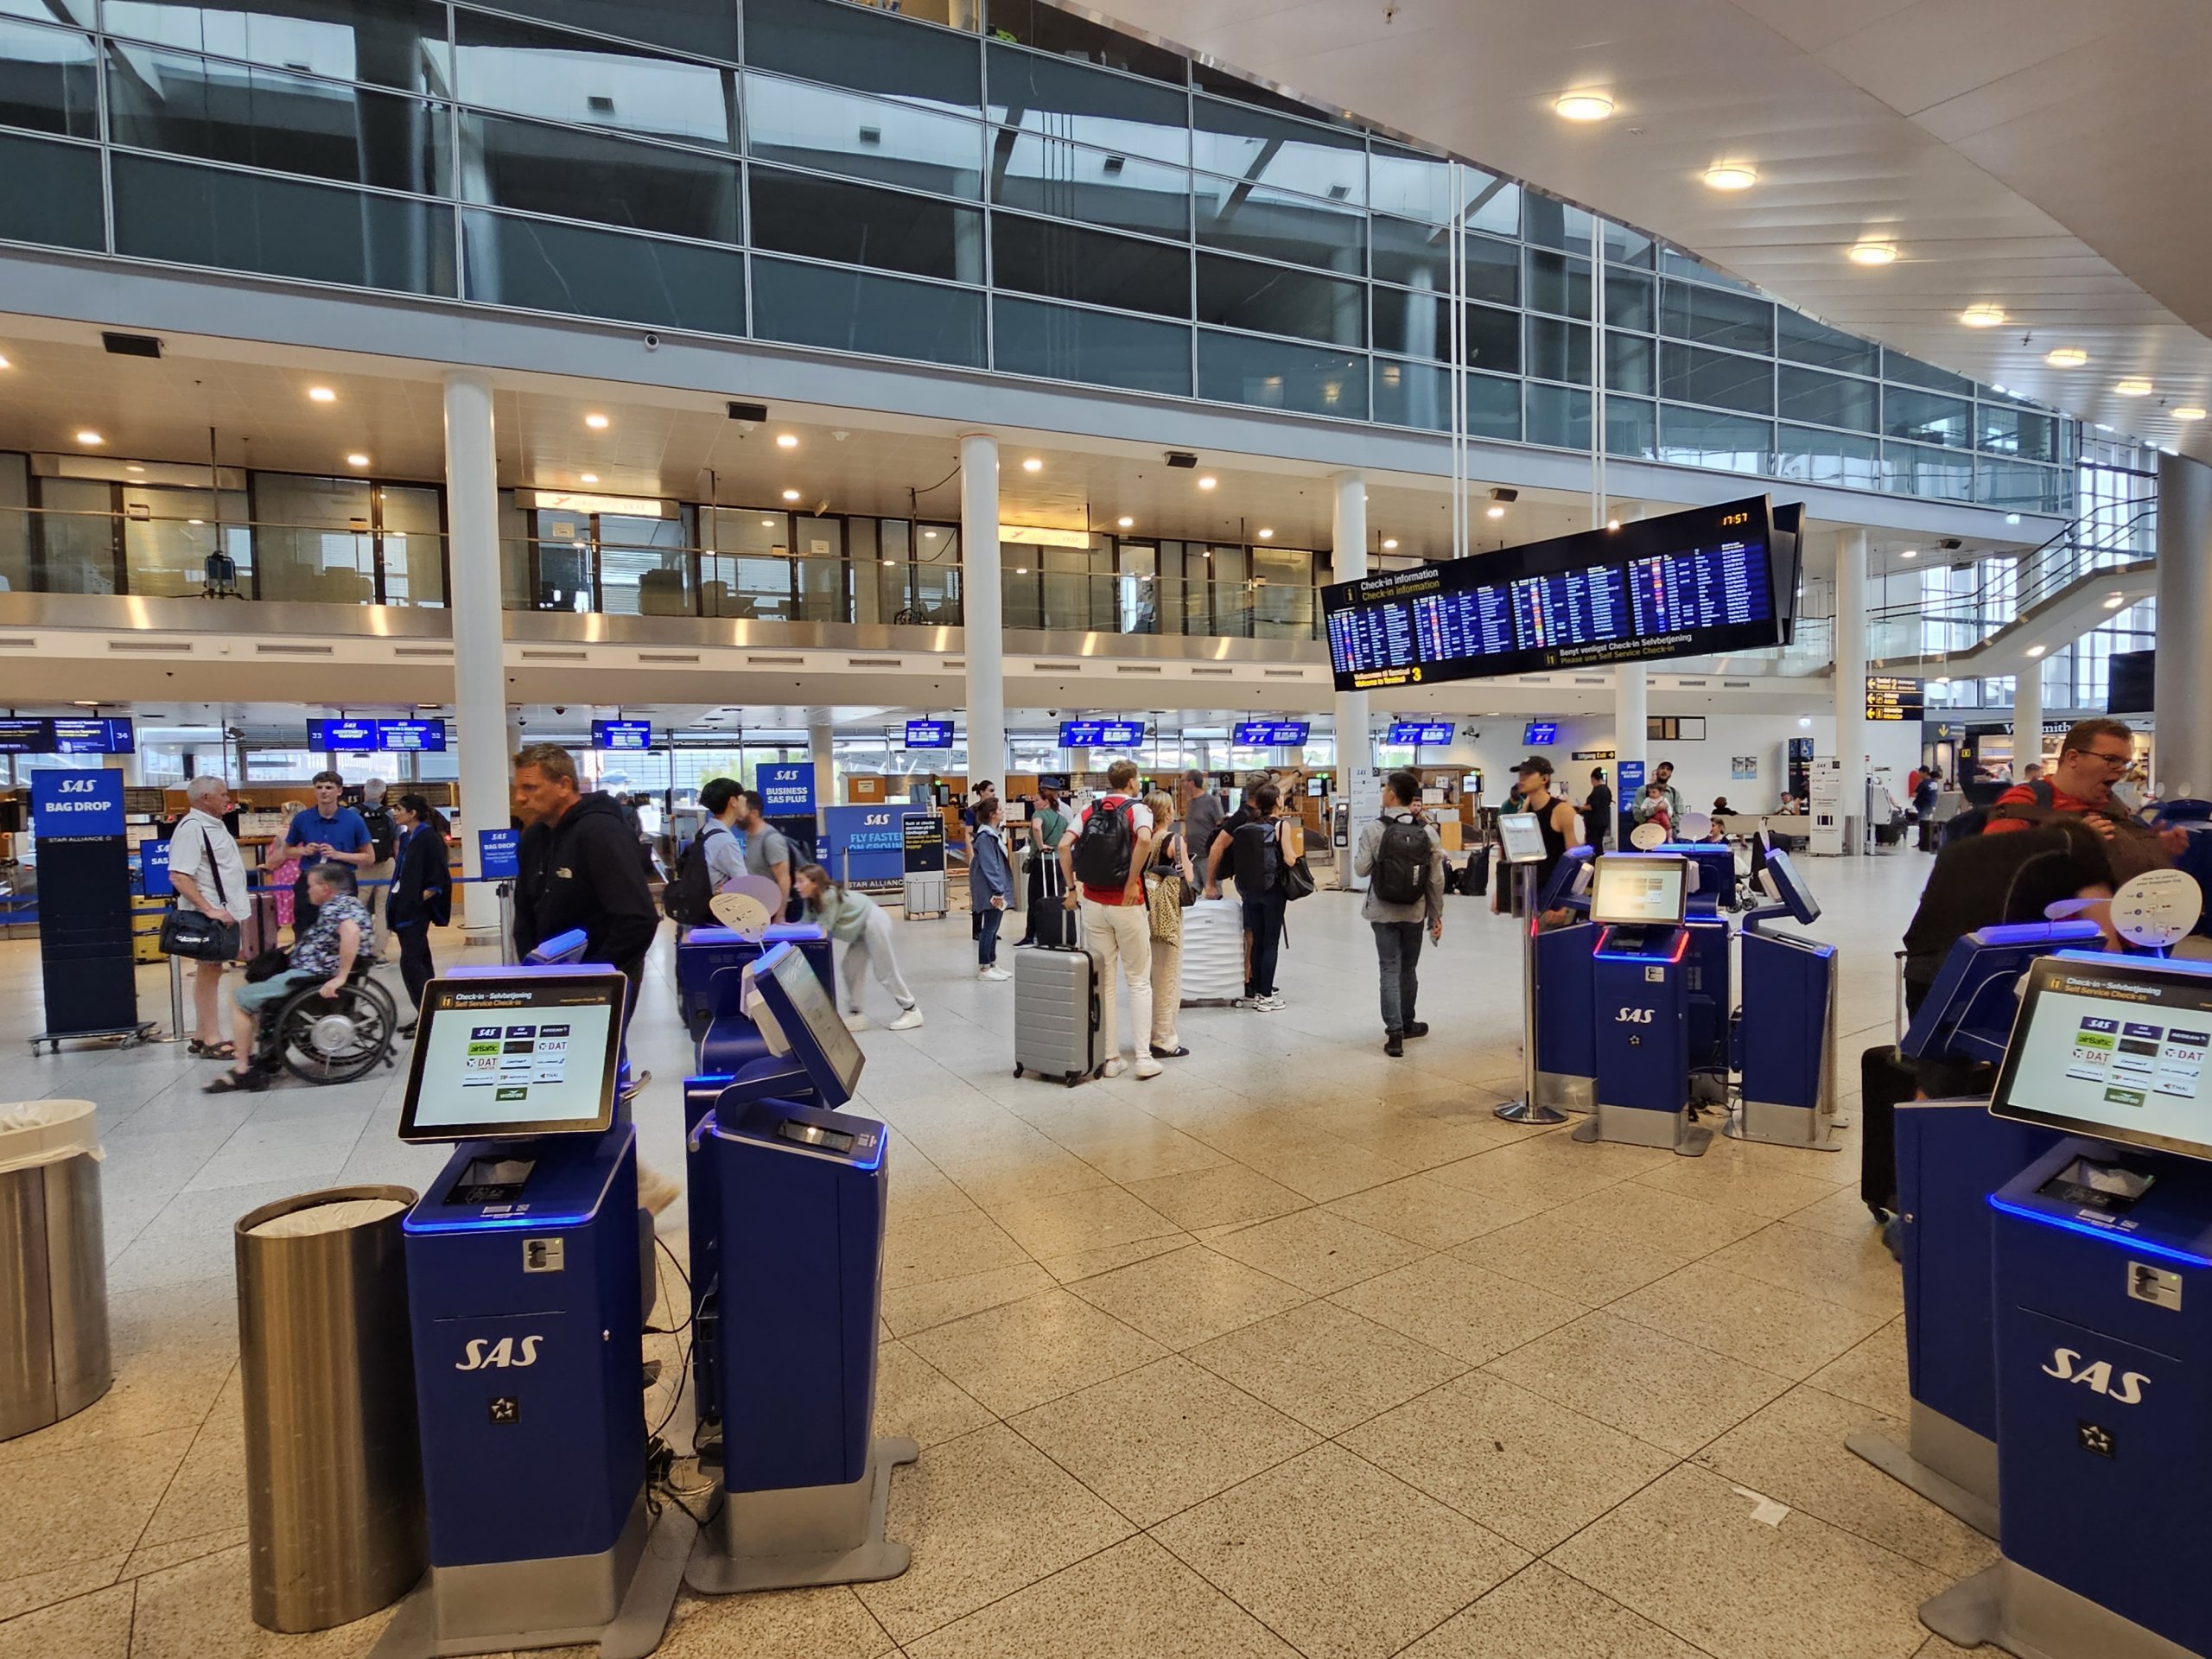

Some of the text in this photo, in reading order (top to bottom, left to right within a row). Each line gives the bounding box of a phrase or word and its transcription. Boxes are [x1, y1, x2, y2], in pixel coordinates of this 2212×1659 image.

[1722, 512, 1748, 526] 17:57
[1360, 569, 1439, 591] Check-in information
[1362, 580, 1440, 601] Check-in information
[1560, 633, 1693, 657] Benyt venligst Check-in Selvbetjening
[1560, 655, 1583, 664] Please
[1599, 652, 1613, 660] Self
[1614, 649, 1640, 658] Service
[1642, 645, 1675, 655] Check-in
[1412, 667, 1422, 681] 3
[1891, 678, 1897, 690] 2
[774, 770, 799, 780] SAS
[58, 779, 97, 793] SAS
[766, 786, 808, 796] BUSINESS
[785, 794, 807, 804] PLUS
[45, 801, 111, 812] BAG DROP
[864, 814, 890, 825] SAS
[850, 833, 868, 842] FLY
[156, 844, 169, 853] SA
[849, 879, 904, 889] STAR ALLIANC
[2066, 977, 2101, 988] Check-in
[2107, 982, 2162, 996] Selvbetjening
[489, 992, 532, 1001] Selvbetjening
[2082, 986, 2109, 996] Service
[2111, 988, 2147, 1001] Check-in
[1615, 1007, 1656, 1023] SAS
[2088, 1020, 2112, 1029] SAS
[477, 1028, 496, 1037] SAS
[2171, 1032, 2200, 1040] AEGEAN
[2078, 1035, 2112, 1046] airBaltic
[471, 1044, 498, 1052] airBaltic
[2086, 1051, 2111, 1062] DAT
[2178, 1050, 2204, 1061] DAT
[478, 1058, 498, 1067] DAT
[455, 1335, 543, 1370] SAS
[2042, 1348, 2152, 1404] SAS
